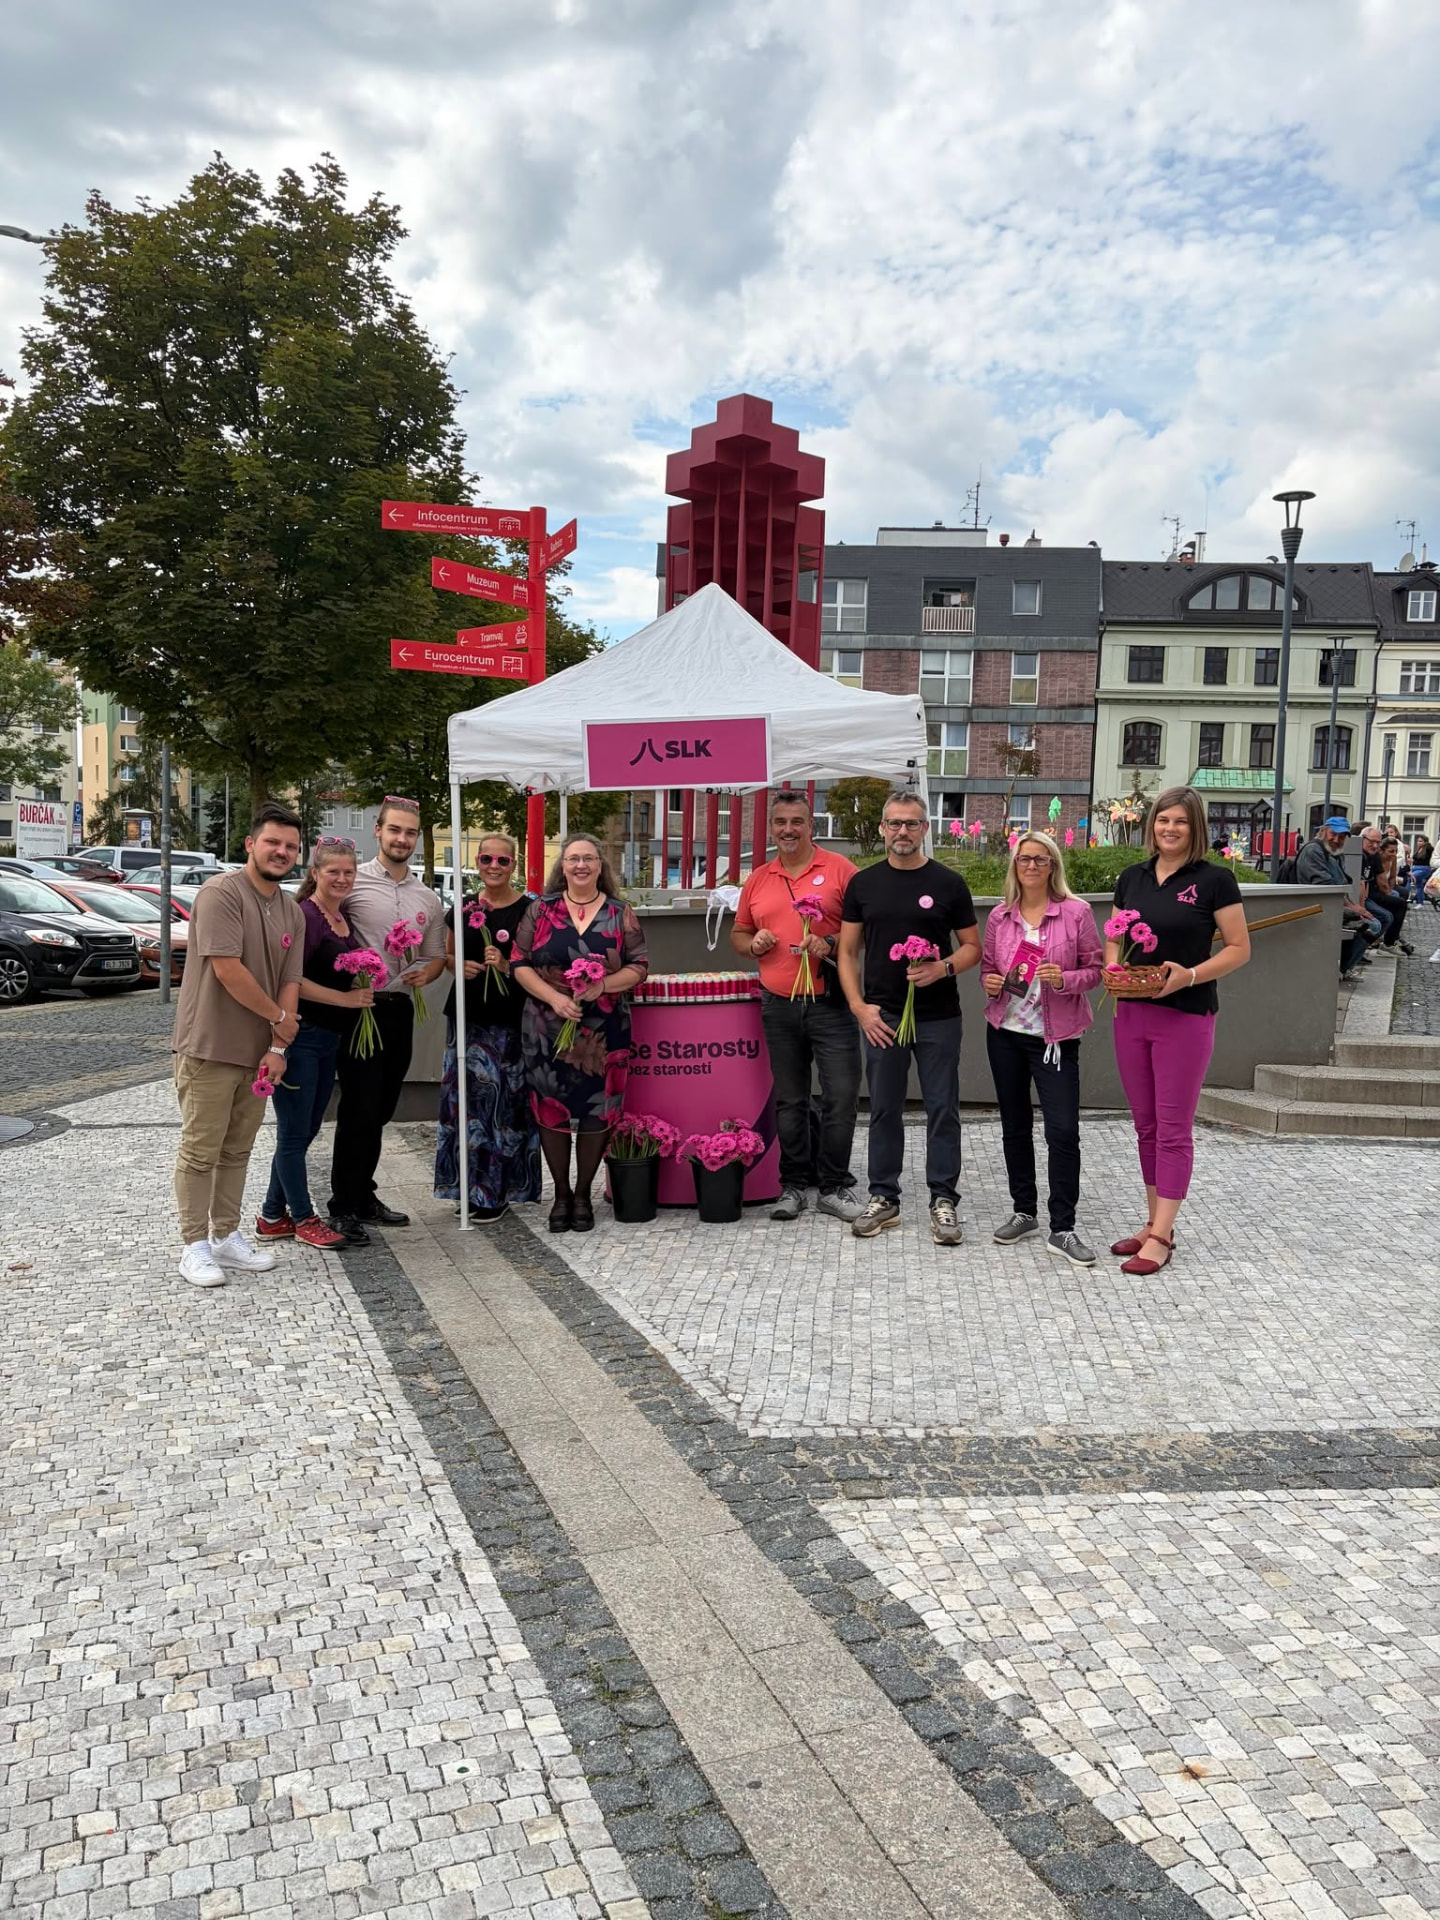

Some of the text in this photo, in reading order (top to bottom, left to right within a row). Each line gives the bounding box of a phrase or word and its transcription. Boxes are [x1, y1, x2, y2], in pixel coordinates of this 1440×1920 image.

[417, 509, 489, 525] Infocentrum
[466, 572, 500, 590] Muzeum
[480, 629, 504, 642] Tramvaj
[424, 649, 495, 666] Eurocentrum
[665, 740, 712, 758] SLK
[1177, 895, 1197, 905] SLK
[657, 1038, 759, 1060] Starosty
